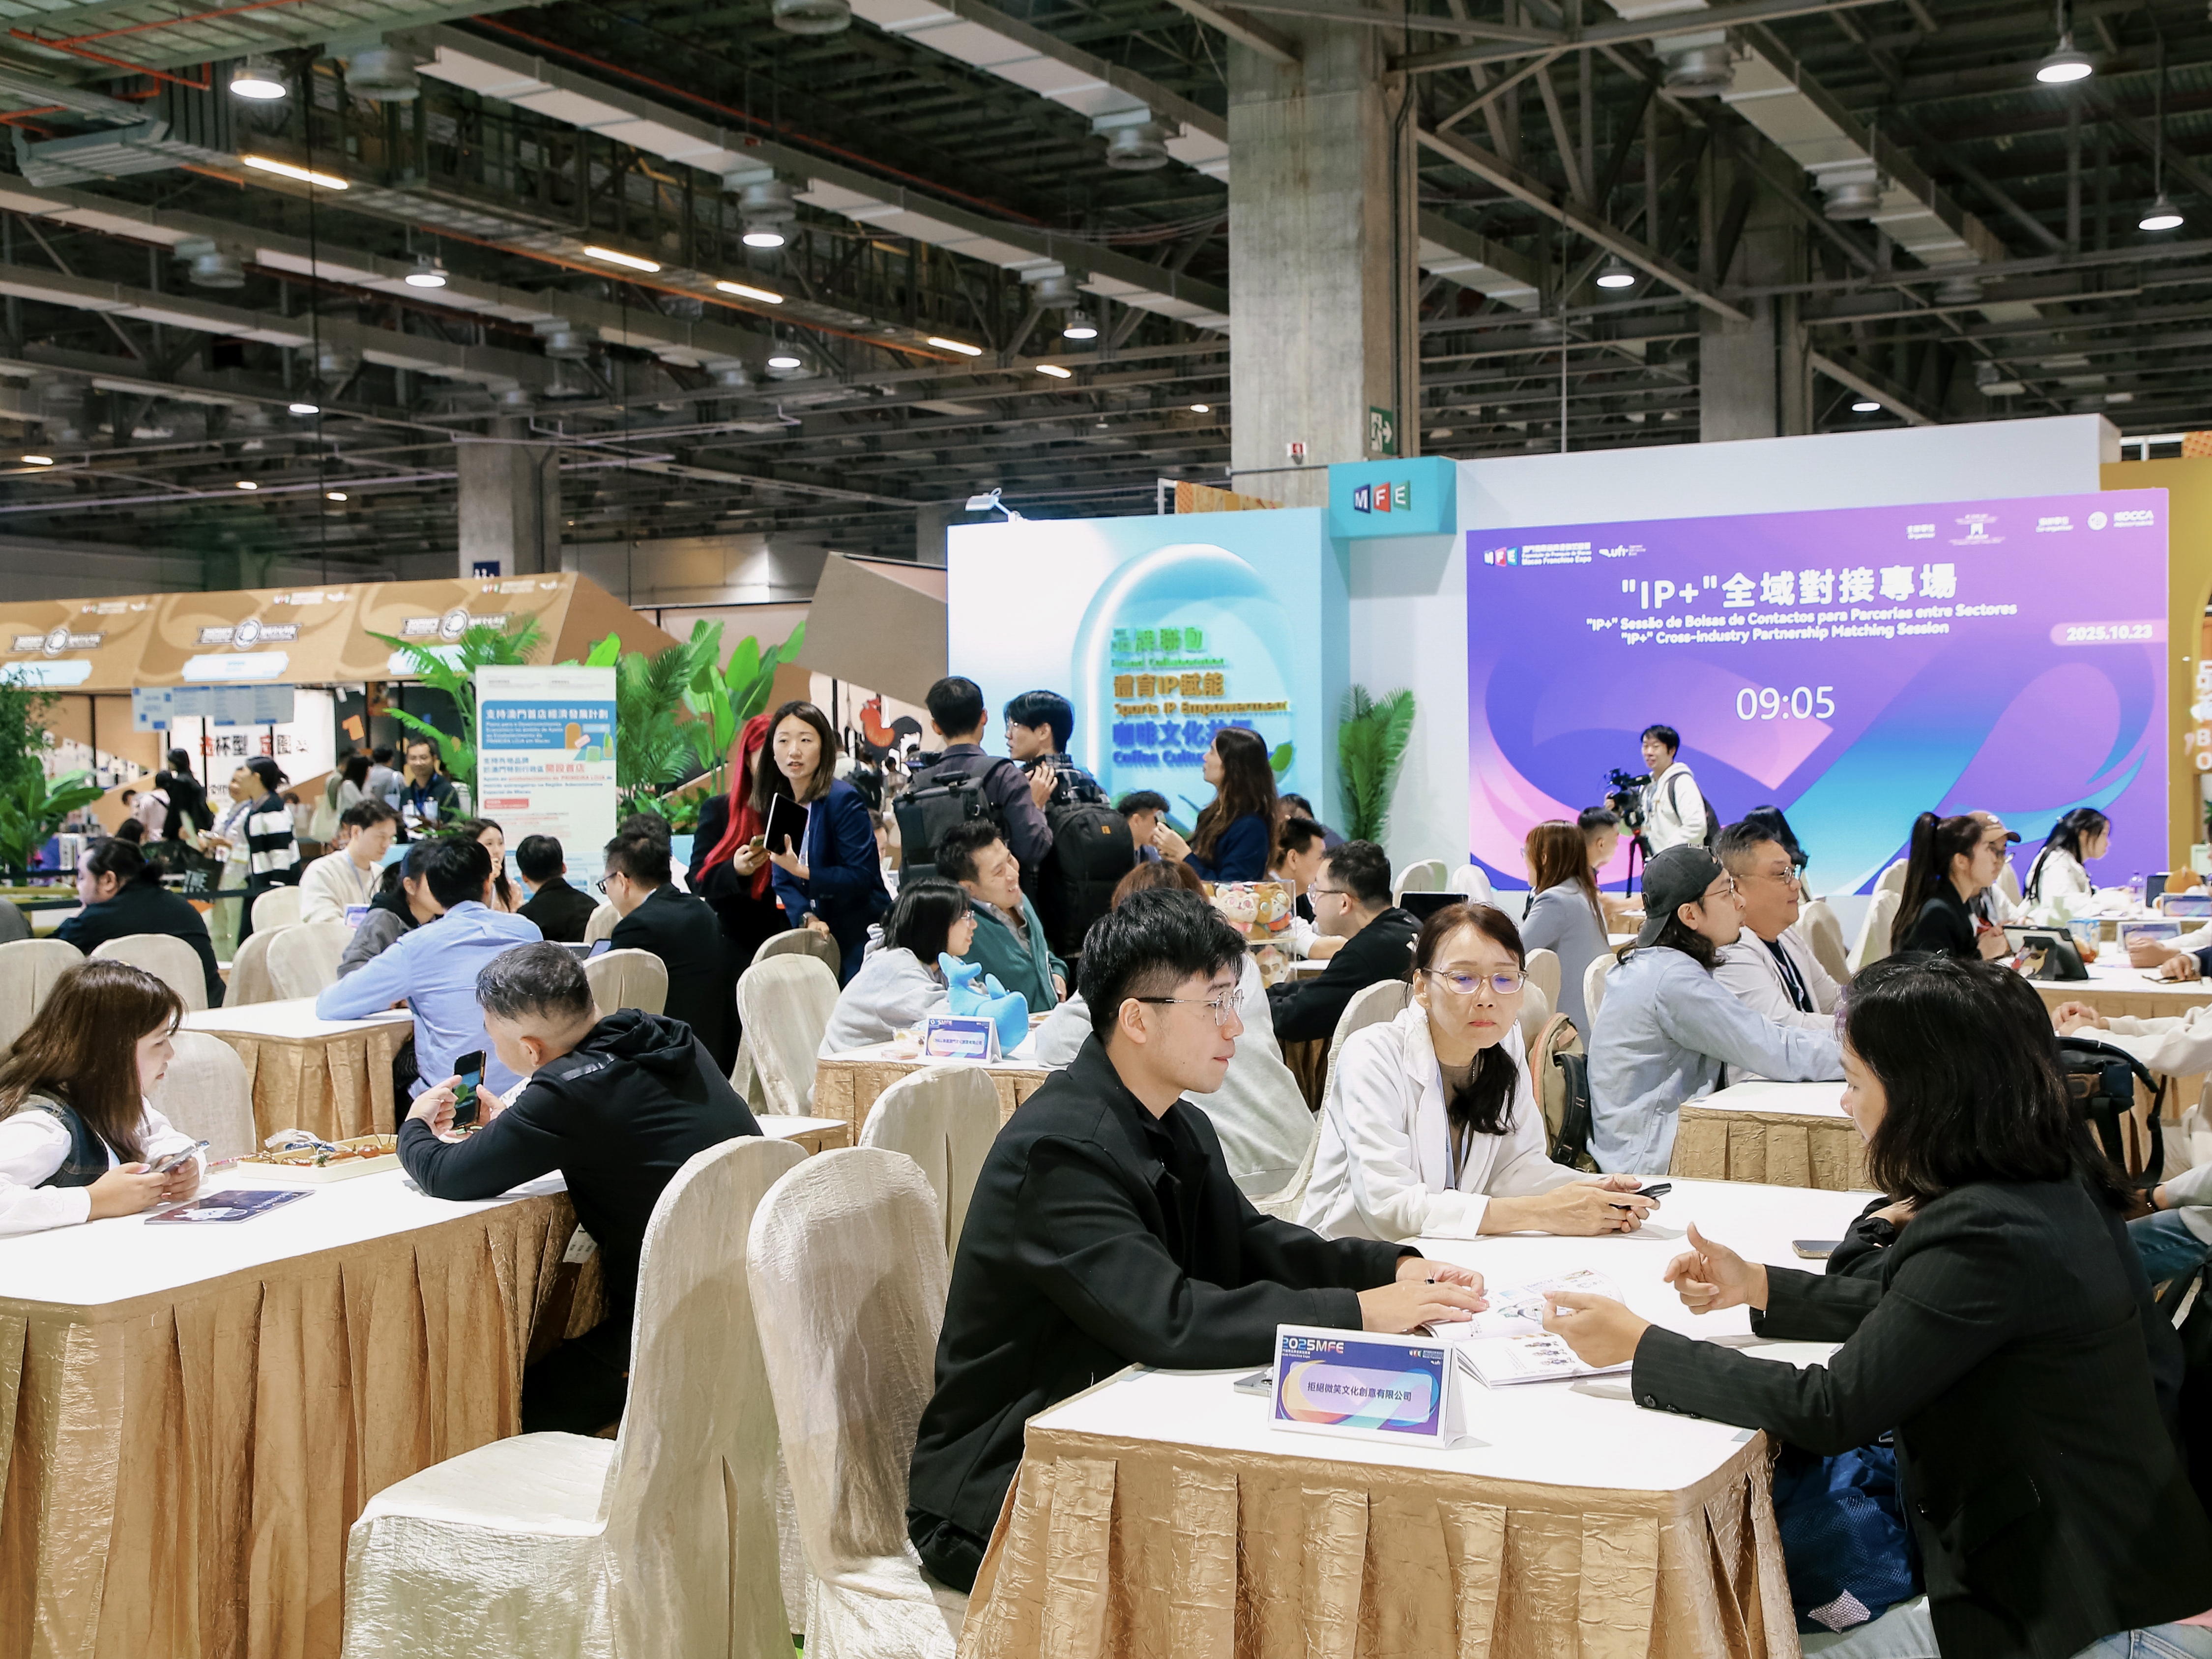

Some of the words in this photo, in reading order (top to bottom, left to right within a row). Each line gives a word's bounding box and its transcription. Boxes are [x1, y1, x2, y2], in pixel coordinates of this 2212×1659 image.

[1354, 485, 1406, 510] MFE
[1484, 548, 1517, 565] MFE
[1586, 616, 1618, 632] "IP+"
[1620, 616, 1663, 630] Sessão
[1665, 615, 1682, 628] de
[1685, 613, 1726, 628] Bolsas
[1728, 612, 1745, 626] de
[1747, 611, 1815, 625] Contactos
[1817, 610, 1848, 625] para
[1850, 606, 1913, 621] Parcerias
[1915, 605, 1953, 619] entre
[1955, 603, 2018, 617] Sectores
[1621, 631, 1653, 645] "IP+"
[1656, 629, 1750, 644] Cross-industry
[1752, 625, 1829, 642] Partnership
[1831, 623, 1895, 640] Matching
[1897, 621, 1950, 635] Session
[2066, 624, 2153, 641] 2025.10.23
[1114, 702, 1159, 718] Sports
[1163, 701, 1176, 714] IP
[1181, 700, 1288, 717] Empowerment
[1736, 686, 1835, 721] 09:05
[1112, 719, 1252, 748] 咖啡文化
[1113, 750, 1160, 766] Coffee
[1283, 1337, 1344, 1354] 2025MFE
